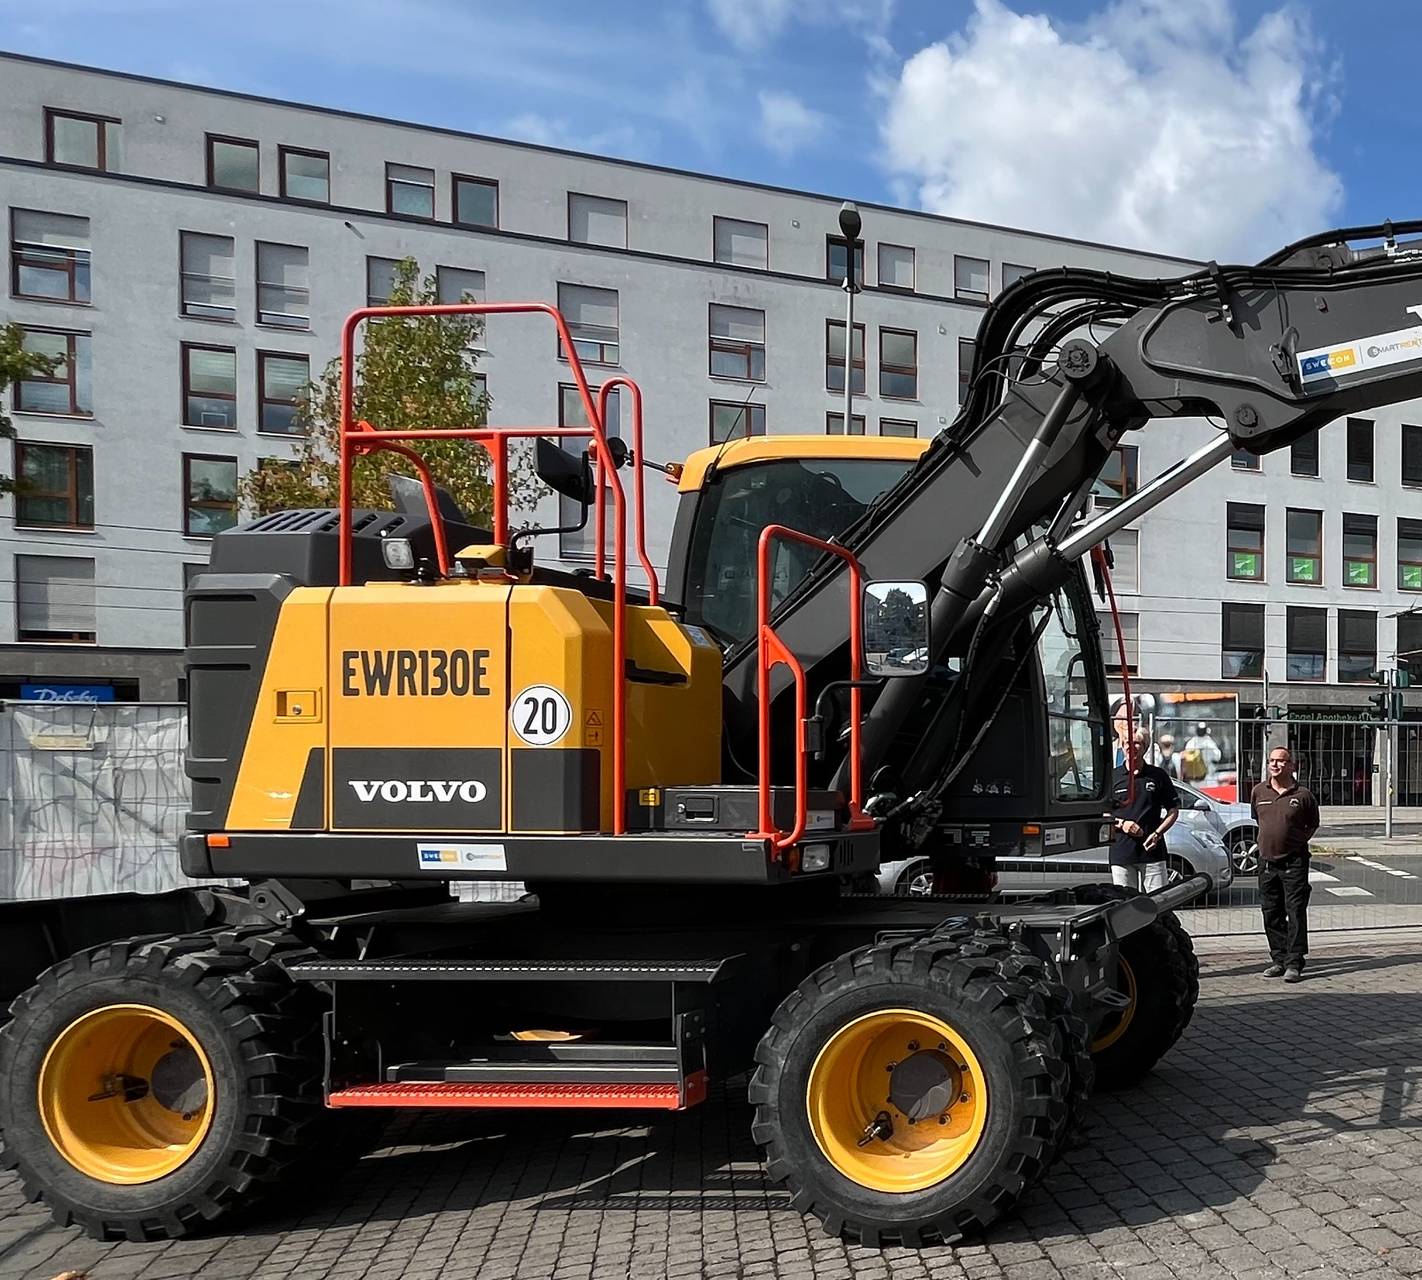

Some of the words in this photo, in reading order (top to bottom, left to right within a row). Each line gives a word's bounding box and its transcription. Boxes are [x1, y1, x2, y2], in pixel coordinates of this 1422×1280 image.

[1305, 354, 1351, 371] SWECON
[342, 649, 491, 697] EWR130E
[523, 697, 557, 735] 20
[348, 780, 487, 803] VOLVO
